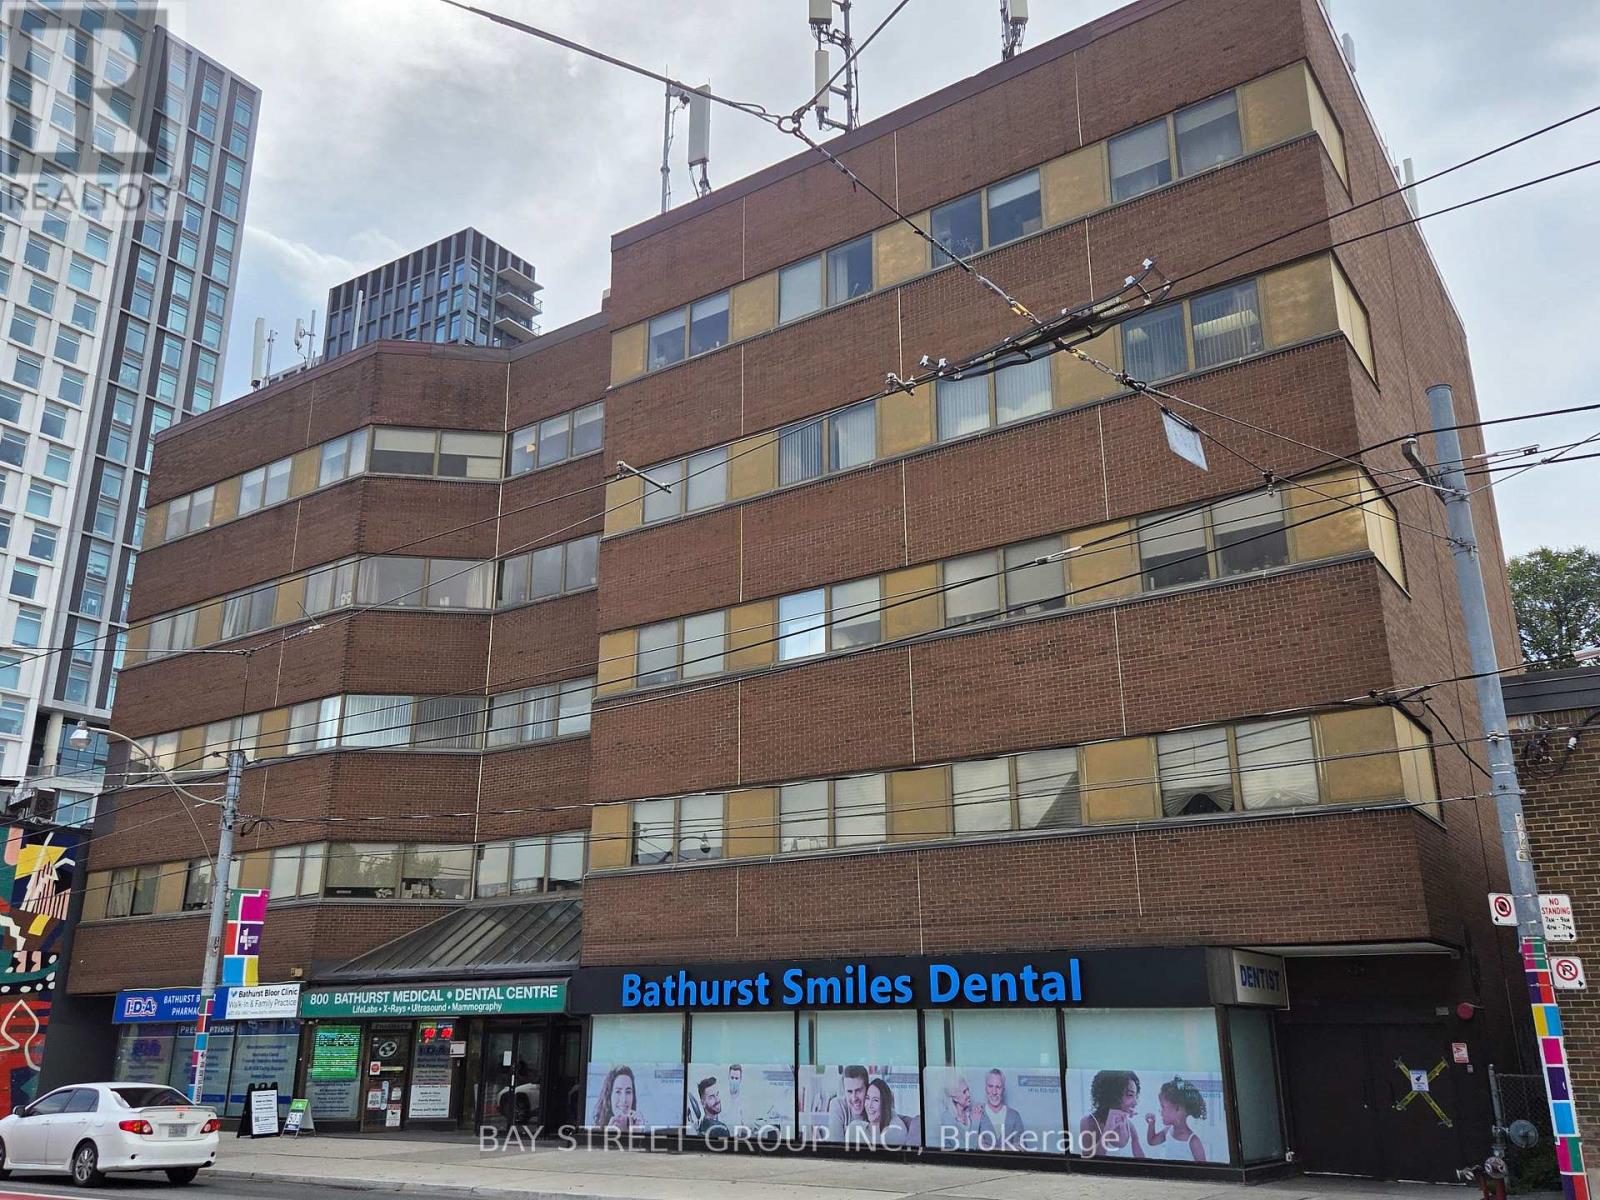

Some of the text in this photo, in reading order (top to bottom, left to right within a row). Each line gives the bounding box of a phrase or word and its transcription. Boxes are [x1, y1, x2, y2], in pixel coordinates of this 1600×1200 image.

[1548, 897, 1559, 906] NO
[1541, 906, 1571, 915] STANDING
[622, 958, 1082, 1008] Bathurst Smiles Dental
[1240, 964, 1280, 992] DENTIST
[238, 986, 298, 998] Bathurst Bloor Clinic
[310, 985, 558, 1005] 800 BATHURST MEDICAL DENTAL CENTRE
[163, 994, 195, 1005] BATHURST
[255, 1000, 273, 1009] Family
[274, 999, 297, 1007] Practice
[171, 1006, 201, 1016] PHARMAC
[352, 1001, 503, 1015] LifeLabs X-Rays Ultrasound Mammography
